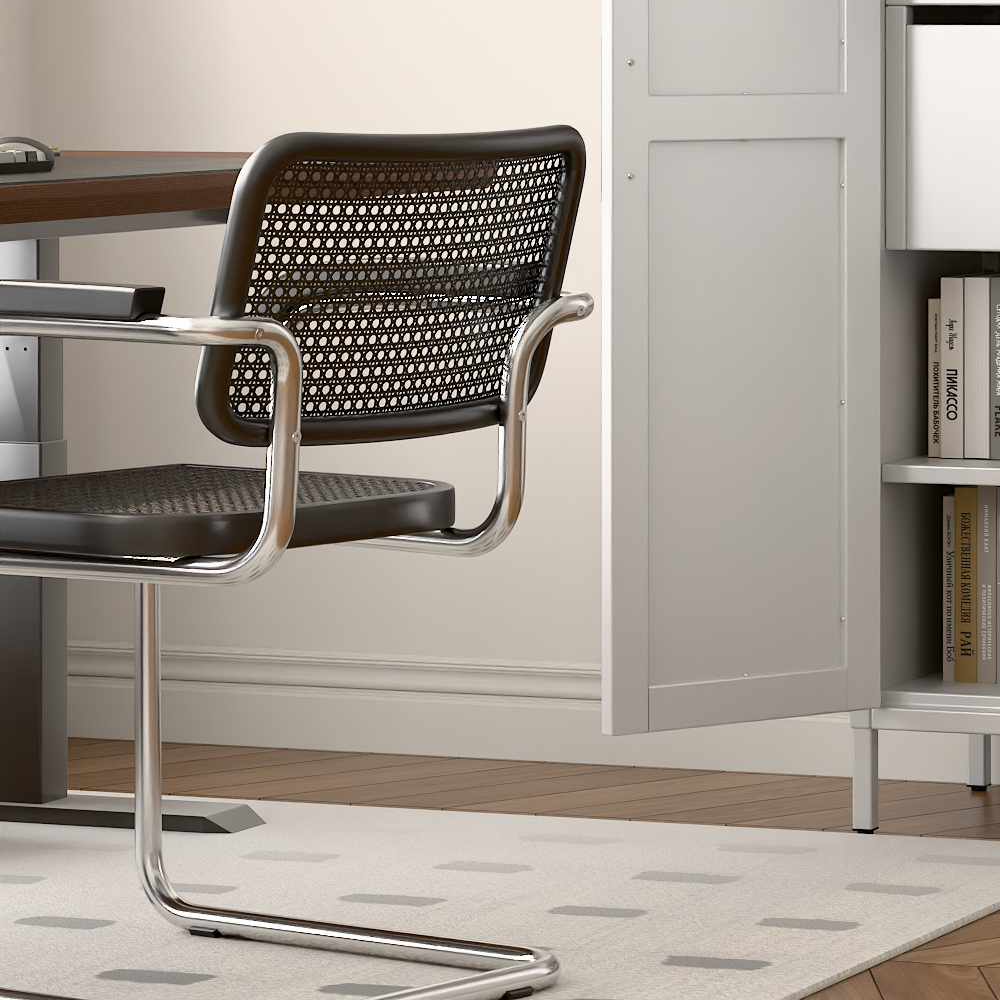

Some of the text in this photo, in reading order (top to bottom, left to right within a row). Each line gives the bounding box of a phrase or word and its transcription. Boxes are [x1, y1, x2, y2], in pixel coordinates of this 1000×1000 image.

[946, 368, 957, 420] ПИКАССО
[946, 551, 954, 587] Уличный
[960, 512, 971, 623] БОЖЕСТВЕННАЯ КОМЕДИЯ
[946, 646, 955, 662] Боб
[960, 631, 974, 656] РАЙ
